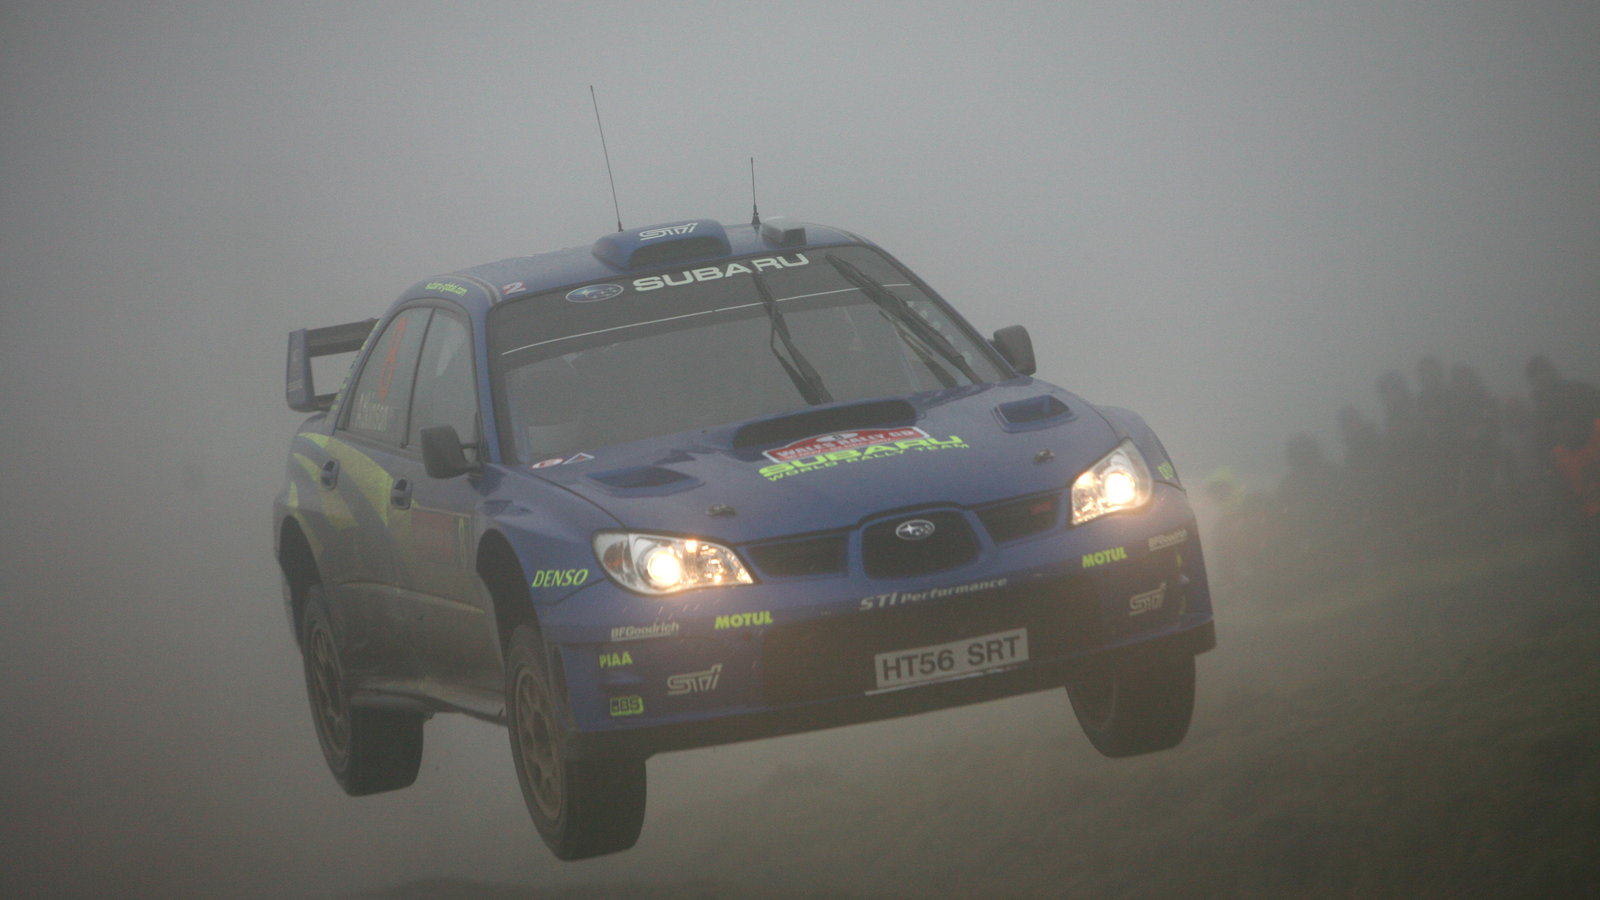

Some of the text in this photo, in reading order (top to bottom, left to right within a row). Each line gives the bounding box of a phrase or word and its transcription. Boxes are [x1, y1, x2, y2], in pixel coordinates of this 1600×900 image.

[632, 252, 810, 292] SUBARU
[759, 435, 964, 478] SUBARU
[768, 461, 838, 482] WORLD
[846, 449, 904, 464] RALLY
[916, 443, 970, 453] TEAM
[1081, 546, 1128, 569] MOTUL
[532, 568, 589, 588] DENSO
[901, 577, 1008, 604] Performance
[611, 621, 680, 640] BFGoodrich
[714, 610, 774, 630] MOTUL
[600, 651, 633, 669] PIAA
[883, 635, 1020, 681] HT56 SRT
